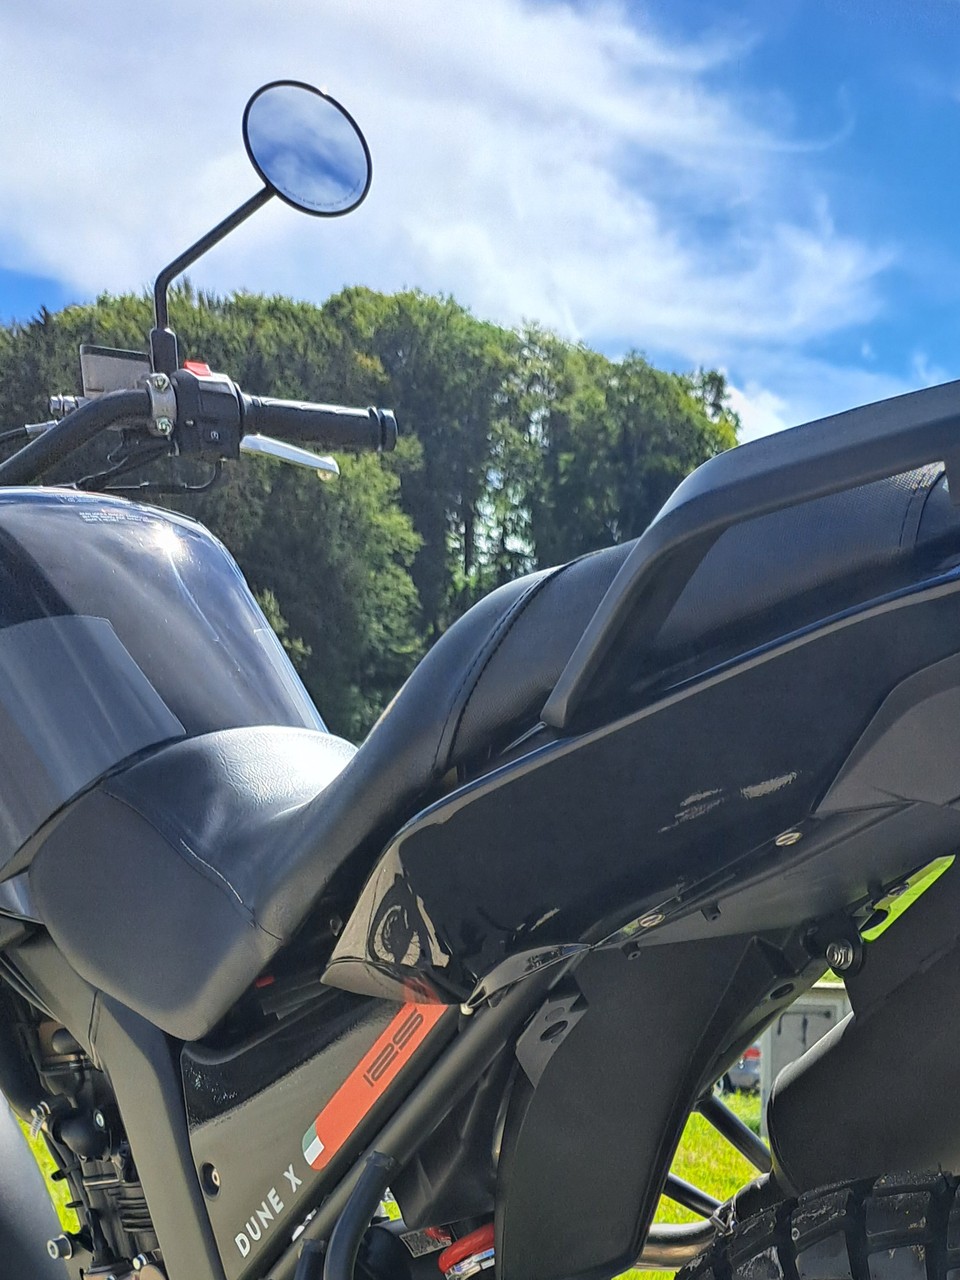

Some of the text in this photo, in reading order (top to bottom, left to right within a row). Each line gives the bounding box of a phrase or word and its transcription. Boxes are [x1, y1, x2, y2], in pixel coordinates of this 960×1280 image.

[362, 1006, 424, 1088] 125
[234, 1163, 303, 1258] DUNE X
